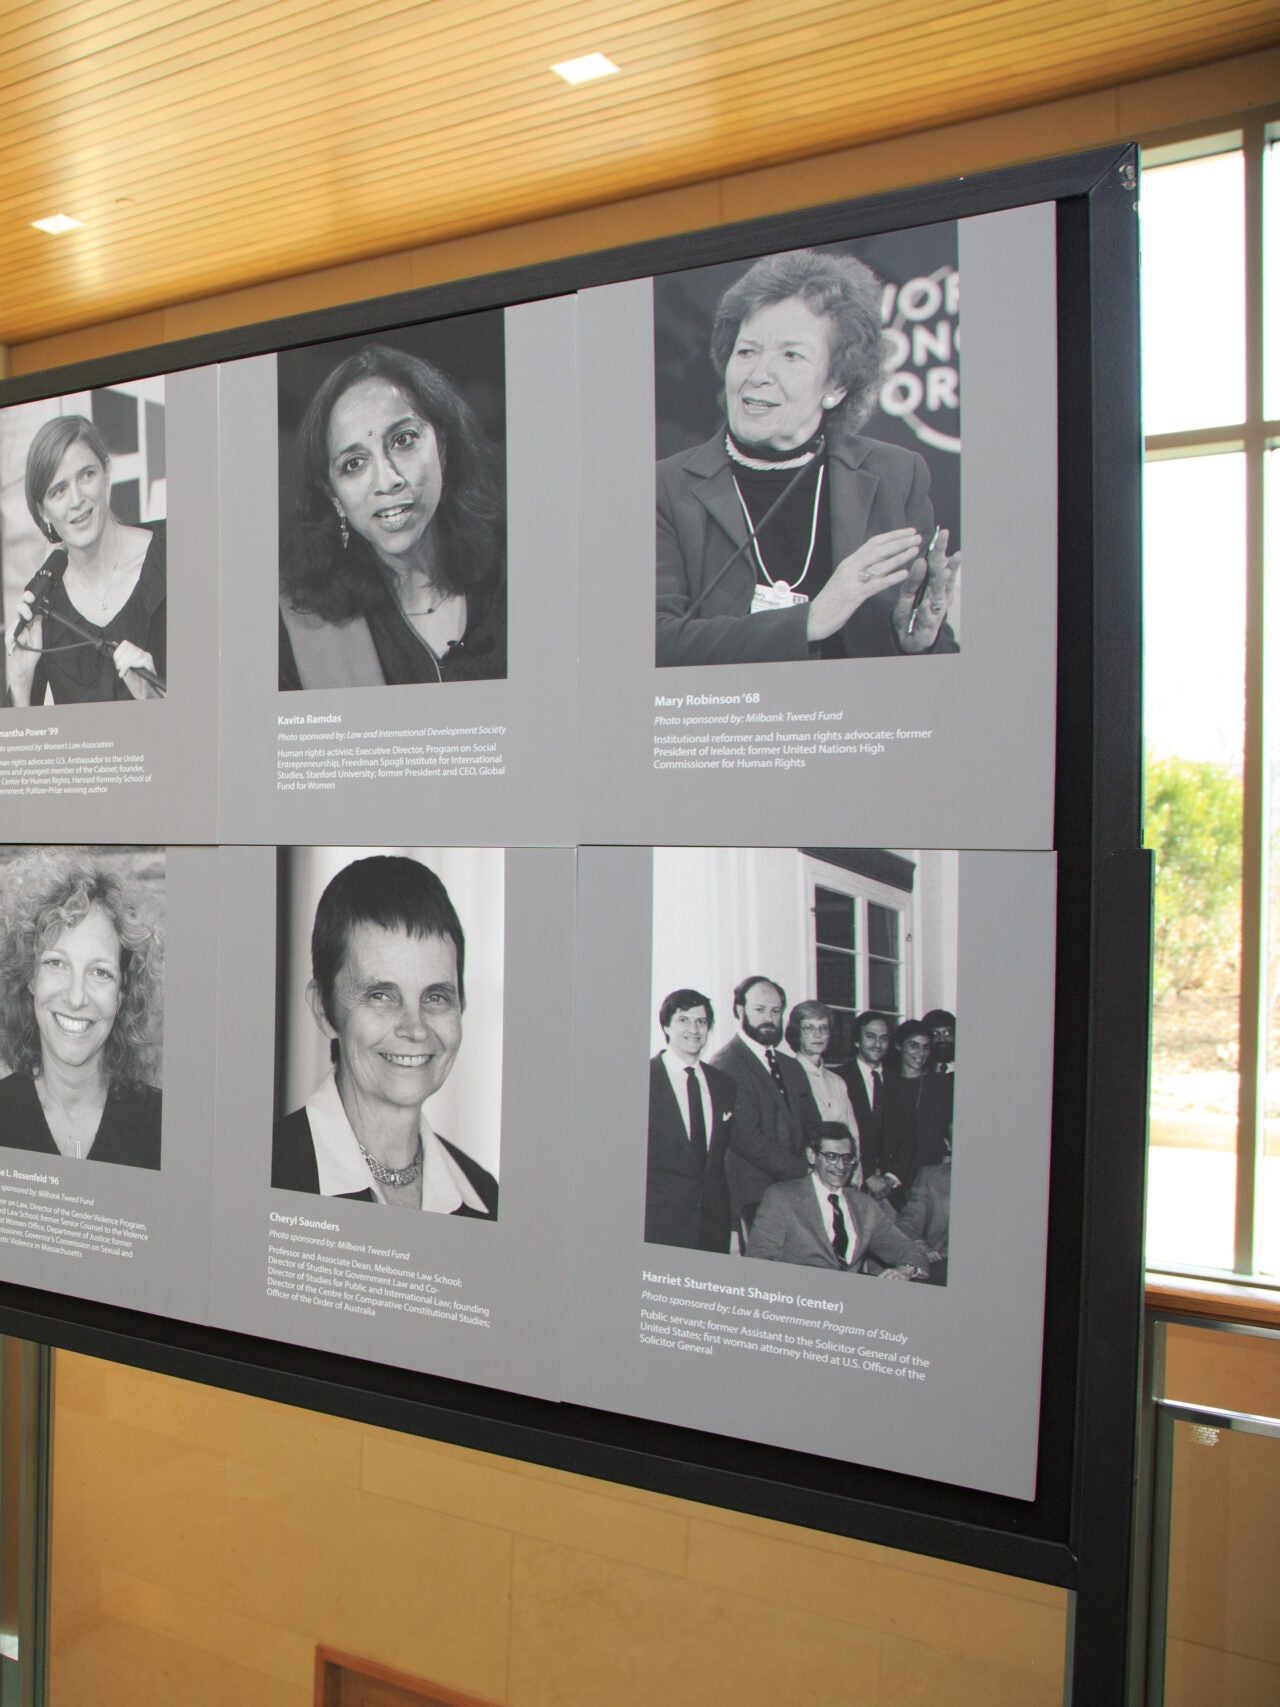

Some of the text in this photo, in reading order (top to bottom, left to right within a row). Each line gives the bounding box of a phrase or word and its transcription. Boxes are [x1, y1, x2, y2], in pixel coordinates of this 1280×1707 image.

[654, 696, 684, 708] Mary
[686, 695, 741, 705] Robinson
[278, 715, 342, 725] Kavita Ramdas
[654, 711, 843, 725] Photo sponsored by: Milbank Tweed Fund
[654, 729, 932, 744] Institutional reformer and human rights advocate; former
[277, 750, 304, 758] Human
[304, 749, 326, 759] rights
[355, 747, 391, 755] Executive
[426, 745, 459, 755] Program
[473, 743, 497, 752] Social
[654, 743, 885, 757] President of Ireland; former United Nations High
[405, 757, 438, 765] Institute
[438, 756, 450, 765] for
[451, 756, 502, 764] International
[653, 758, 806, 770] Commissioner for Human Rights
[306, 770, 337, 779] Stanford
[378, 769, 404, 777] former
[405, 768, 441, 777] President
[442, 768, 458, 776] and
[479, 767, 505, 775] Global
[277, 781, 336, 790] Fund for Women
[269, 1213, 340, 1231] Cheryl Saunders
[268, 1245, 301, 1258] Professor
[301, 1252, 316, 1261] and
[316, 1254, 351, 1267] Associate
[374, 1264, 416, 1278] Melbourne
[417, 1272, 433, 1281] Law
[434, 1274, 462, 1287] School;
[268, 1256, 296, 1268] Director
[297, 1261, 306, 1270] of
[306, 1263, 332, 1275] Studies
[333, 1267, 344, 1277] for
[345, 1270, 391, 1285] Government
[392, 1279, 408, 1288] Law
[409, 1283, 424, 1291] and
[642, 1271, 843, 1313] Harriet Sturtevant Shapiro (center)
[266, 1288, 376, 1316] Officer of the Order of Australia
[641, 1290, 908, 1345] Photo sponsored by: Law & Government Program of Study
[639, 1334, 713, 1355] Solicitor General
[640, 1309, 930, 1368] Public servant; former Assistant to the Solicitor General of the
[640, 1322, 926, 1380] United States; first woman attorney hired at U.S. Office of the
